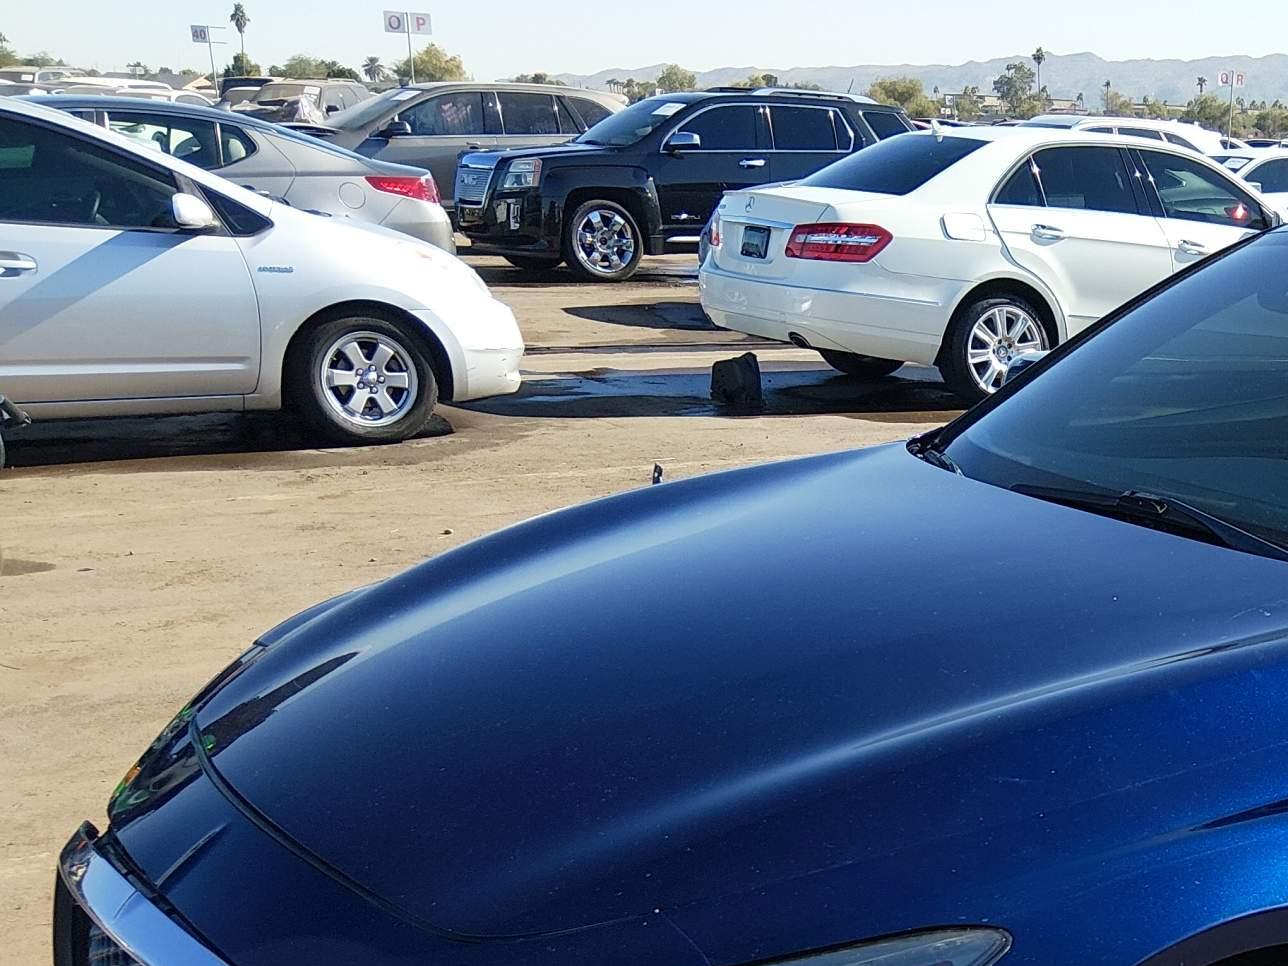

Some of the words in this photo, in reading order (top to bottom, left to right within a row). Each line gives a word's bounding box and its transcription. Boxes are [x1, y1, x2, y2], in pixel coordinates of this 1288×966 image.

[387, 14, 402, 30] O
[415, 16, 427, 31] P
[192, 28, 207, 41] 40
[1220, 72, 1229, 84] Q
[1236, 74, 1244, 86] R
